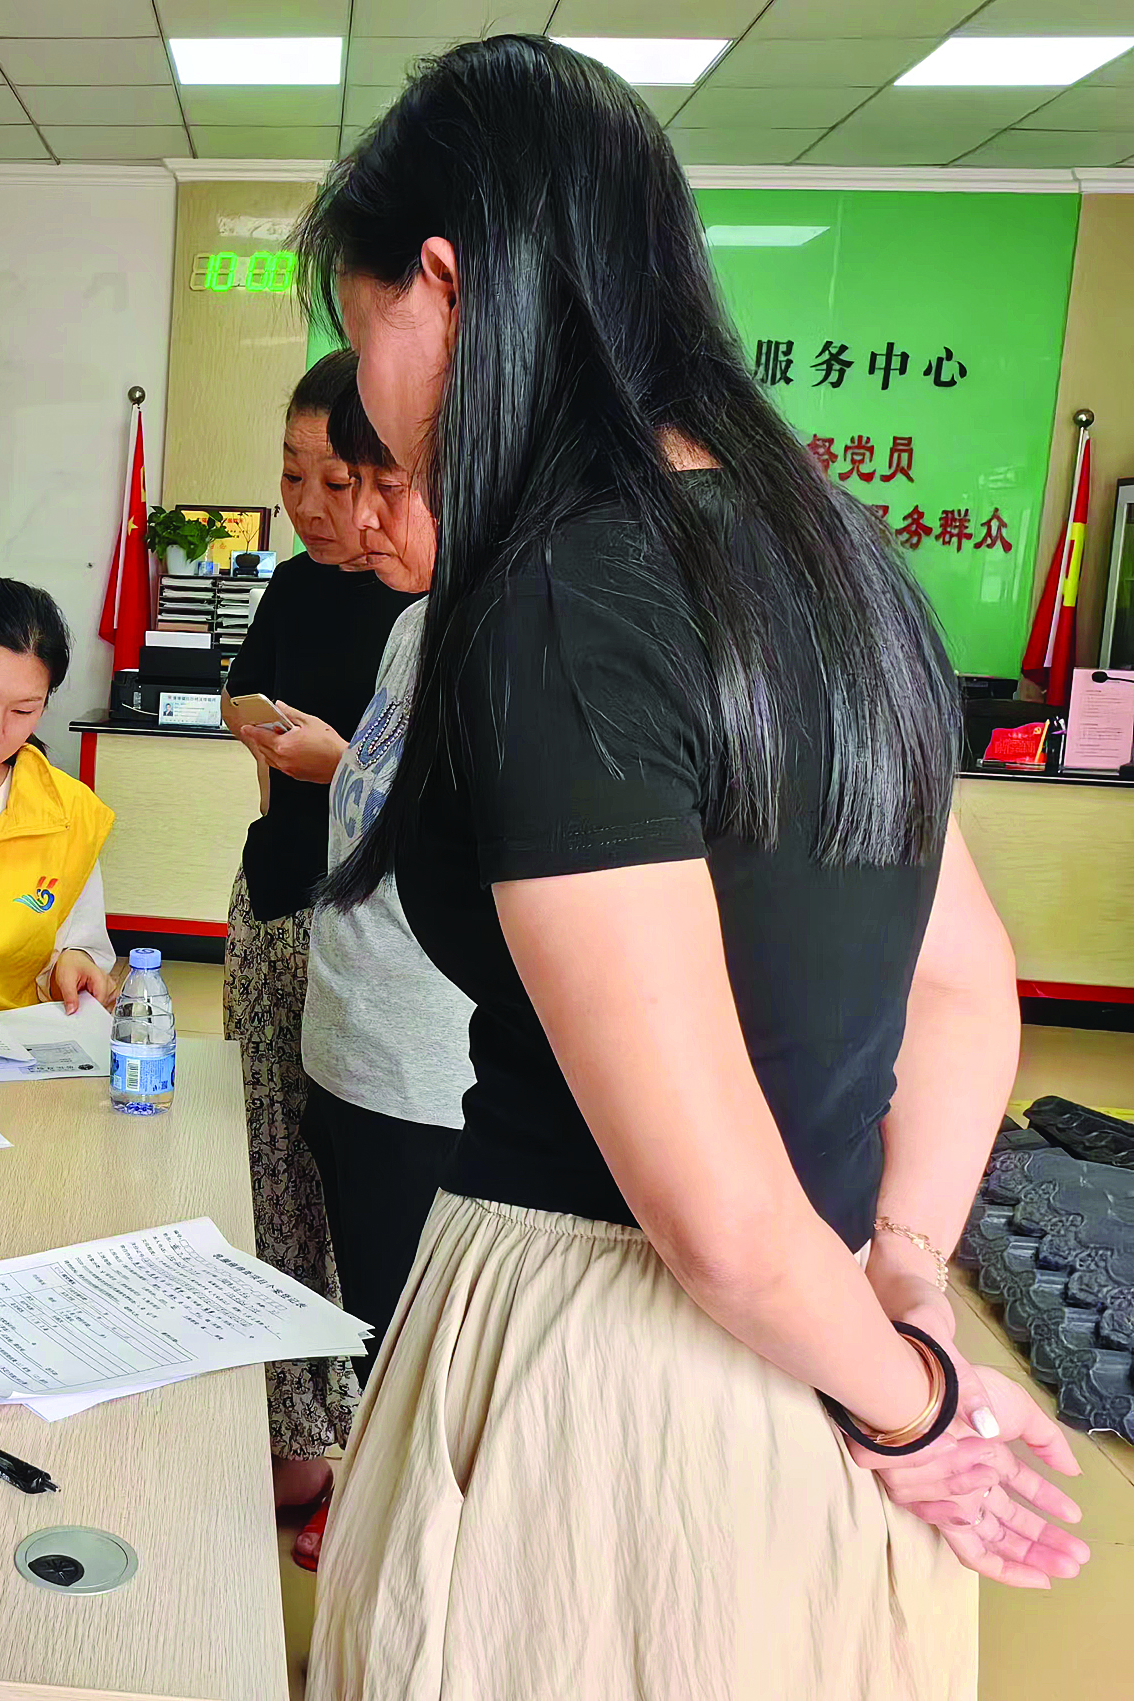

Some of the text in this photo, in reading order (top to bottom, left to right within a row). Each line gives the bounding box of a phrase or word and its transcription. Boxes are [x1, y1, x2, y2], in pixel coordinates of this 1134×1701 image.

[754, 339, 967, 391] 服务中心
[870, 504, 1013, 553] 务群众
